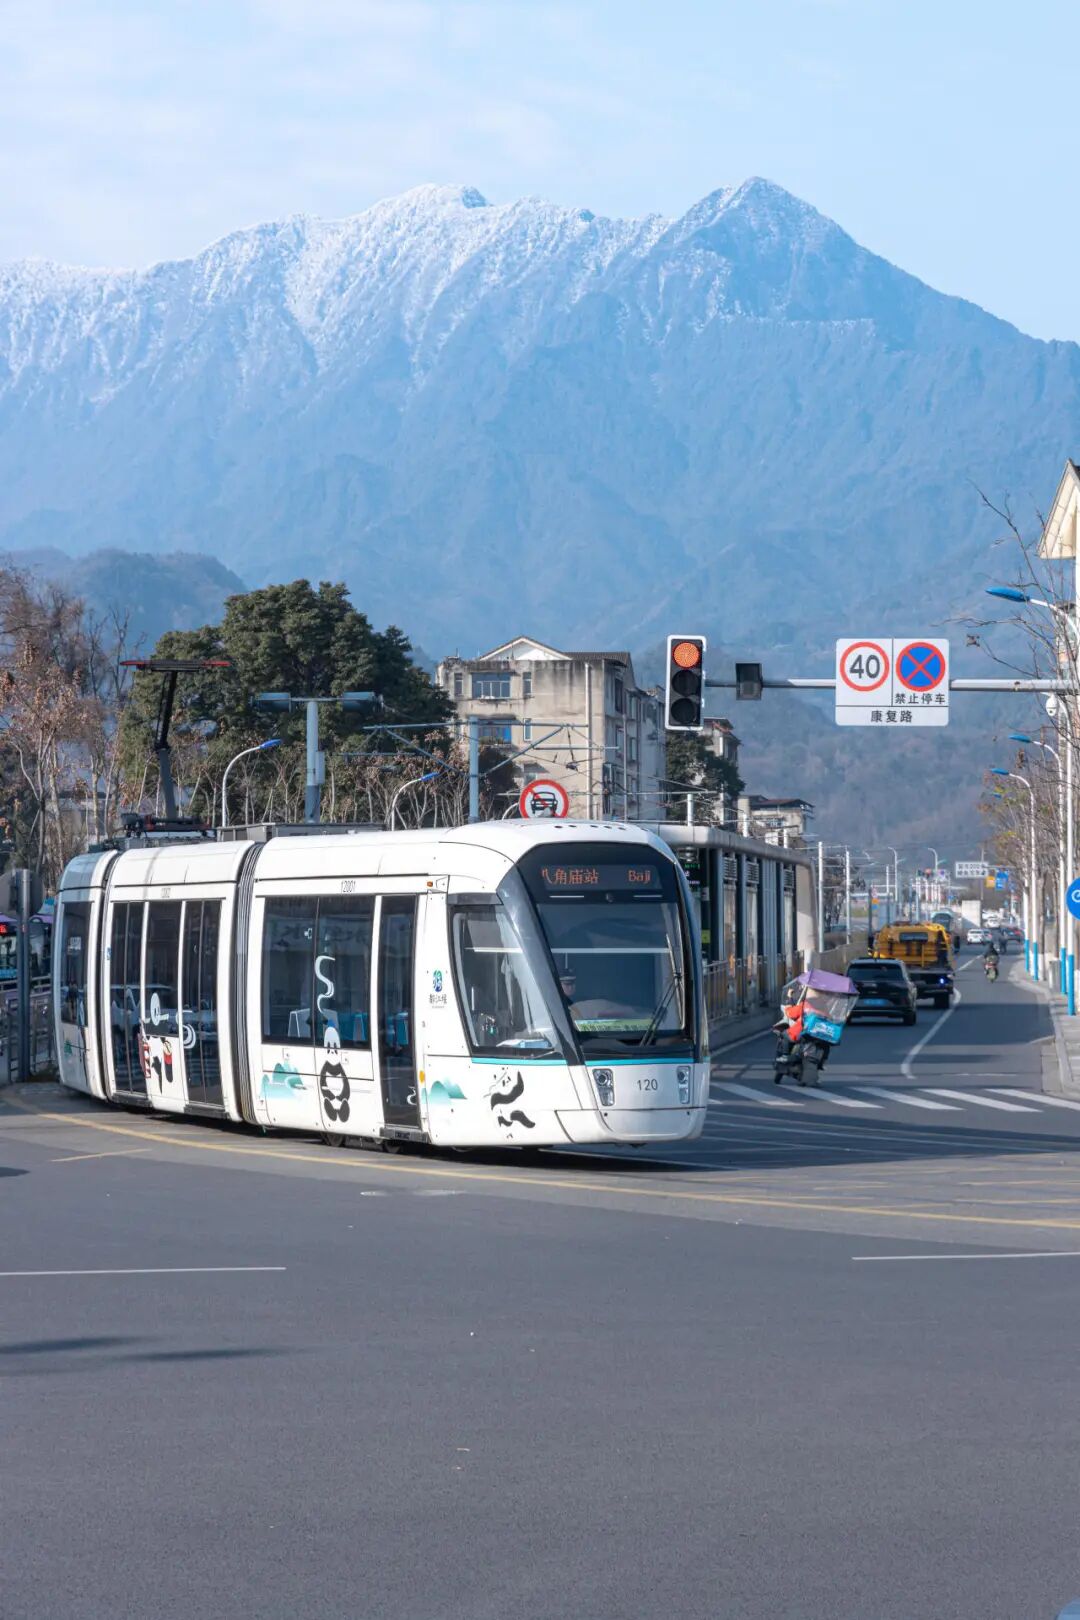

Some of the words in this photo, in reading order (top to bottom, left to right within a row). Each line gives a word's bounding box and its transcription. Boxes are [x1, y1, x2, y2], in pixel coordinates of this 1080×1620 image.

[849, 654, 881, 679] 40
[894, 693, 946, 705] 禁止停车
[870, 710, 913, 723] 康复路
[636, 1078, 658, 1091] 120
